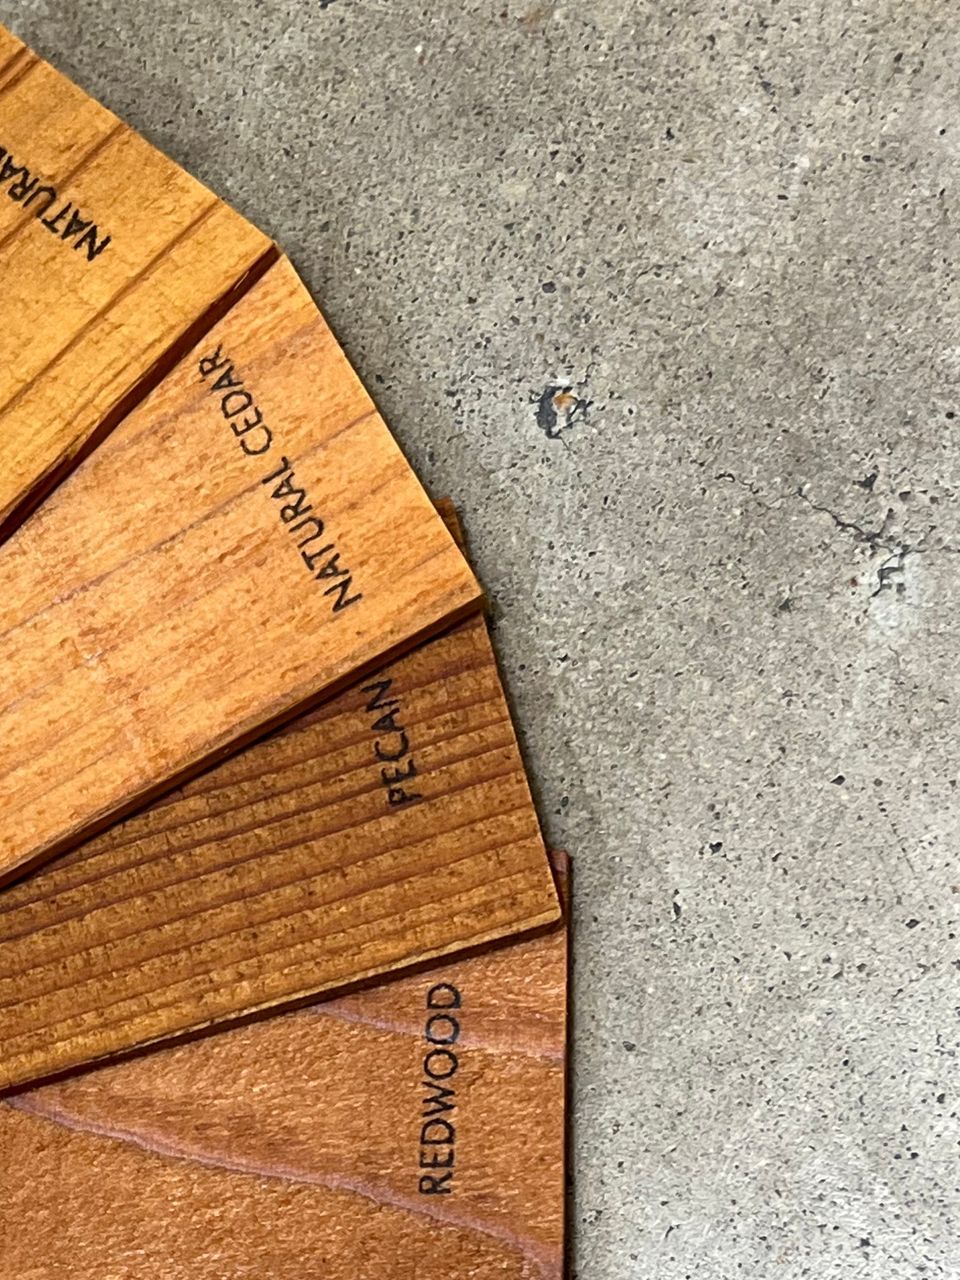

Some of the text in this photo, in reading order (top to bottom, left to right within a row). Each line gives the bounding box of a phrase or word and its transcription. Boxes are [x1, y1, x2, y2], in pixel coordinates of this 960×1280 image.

[198, 343, 363, 613] NATURAL CEDAR
[359, 678, 423, 807] PECAN
[419, 982, 461, 1195] REDWOOD
